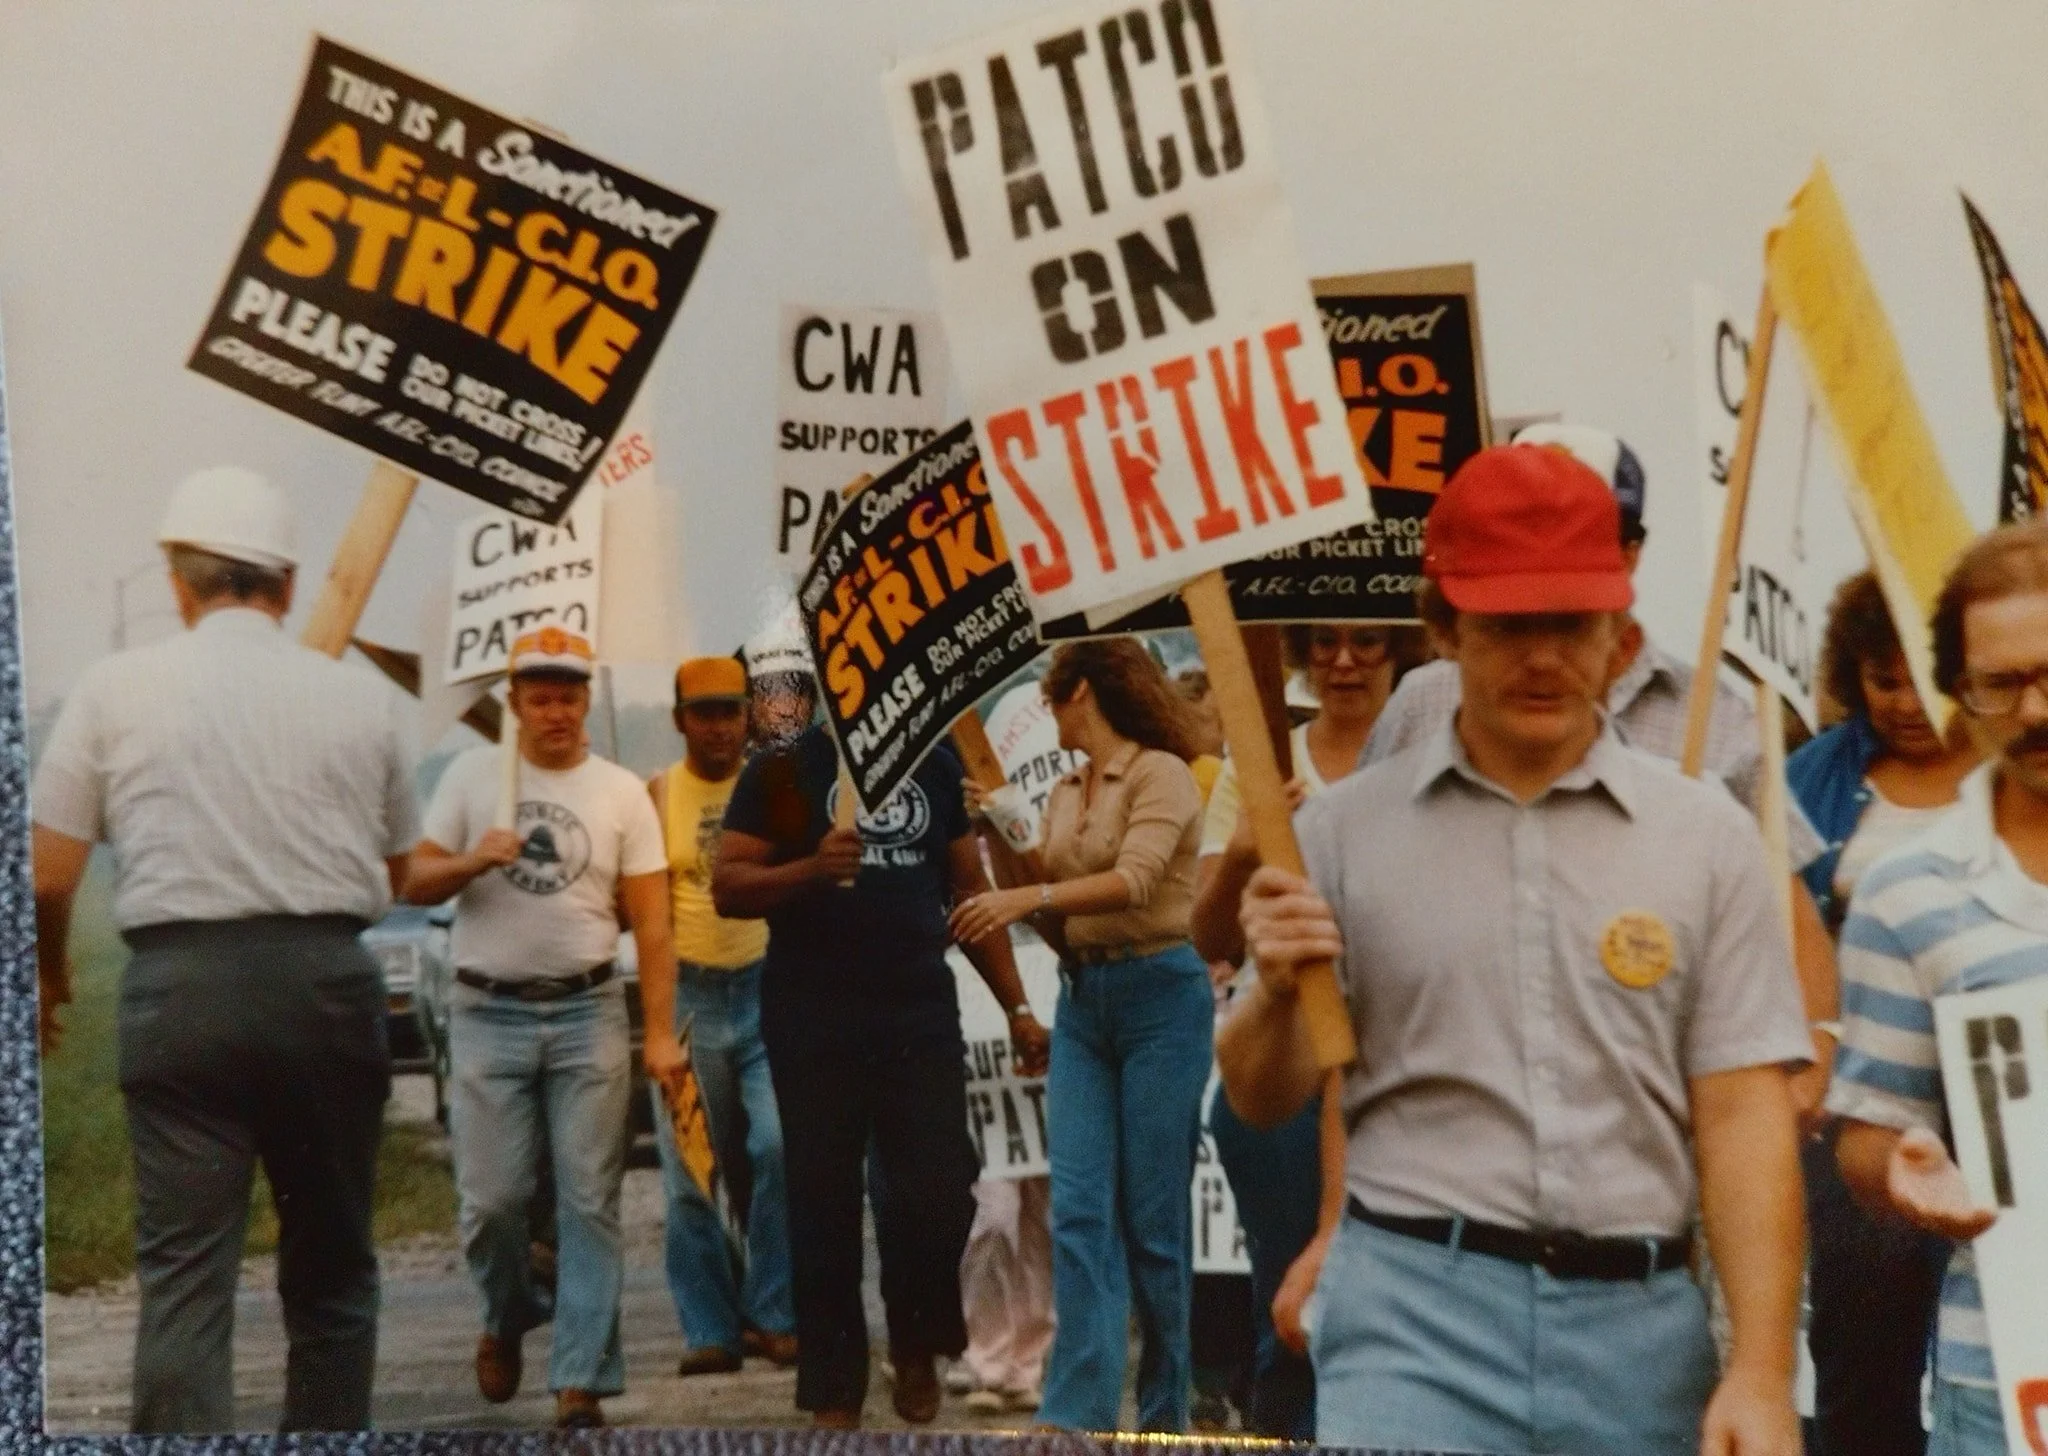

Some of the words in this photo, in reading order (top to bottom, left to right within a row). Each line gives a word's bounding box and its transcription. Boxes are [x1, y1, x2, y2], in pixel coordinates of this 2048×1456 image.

[327, 65, 399, 126] THIS
[400, 99, 439, 142] IS
[434, 117, 467, 160] A
[476, 128, 701, 250] Sanctioned
[909, 0, 1246, 261] PATCO
[230, 276, 399, 384] PLEASE
[408, 353, 450, 387] DO
[453, 372, 509, 411] NOT
[509, 398, 588, 447] CROSS
[262, 178, 642, 406] STRIKE
[793, 317, 922, 398] CWA
[1031, 211, 1217, 365] ON
[985, 321, 1347, 597] STRIKE
[458, 557, 594, 609] SUPPORTS
[1310, 538, 1384, 560] PICKET
[846, 662, 927, 766] PLEASE
[926, 635, 952, 662] DO
[953, 605, 986, 641] NOT
[932, 643, 965, 675] OUR
[1964, 1014, 2031, 1208] P
